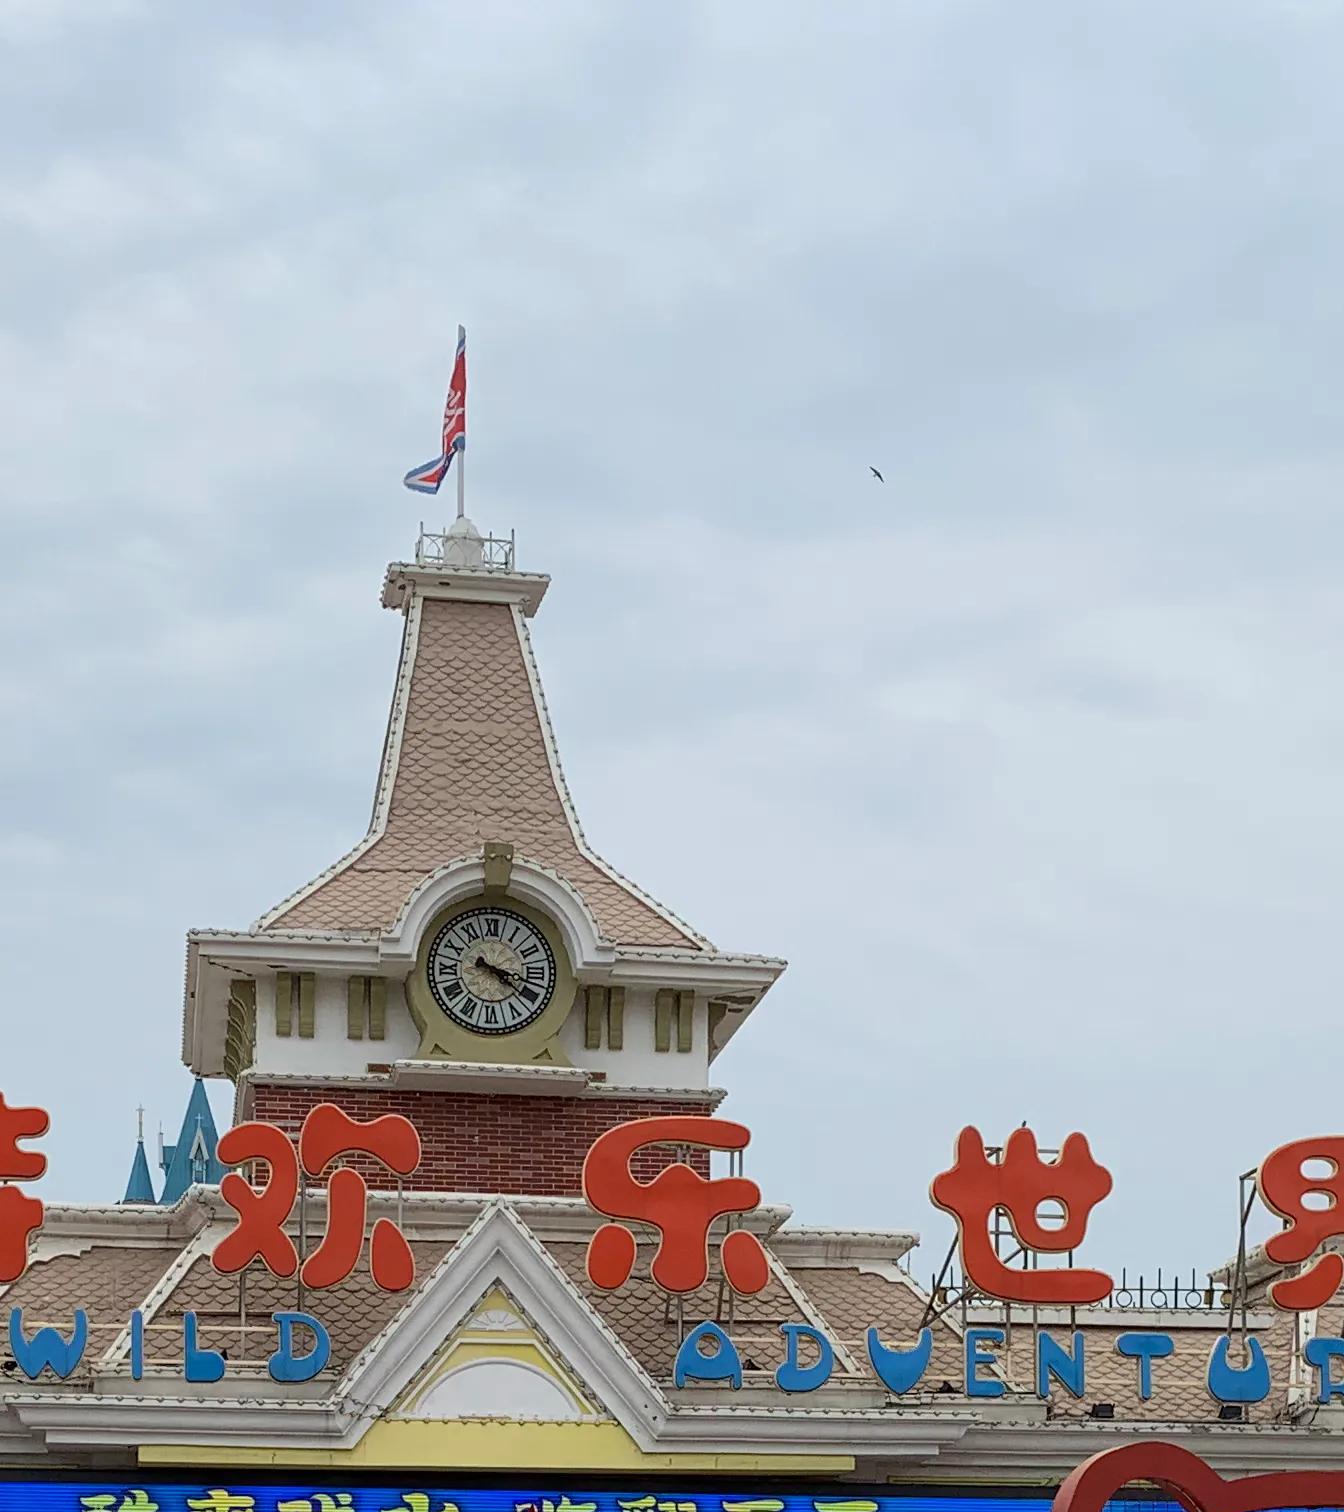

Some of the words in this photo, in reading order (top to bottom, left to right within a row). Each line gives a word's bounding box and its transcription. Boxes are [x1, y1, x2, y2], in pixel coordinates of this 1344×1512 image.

[461, 922, 480, 943] XI
[485, 918, 499, 937] XII
[508, 926, 521, 943] I
[444, 939, 464, 957] X
[521, 944, 539, 959] II
[439, 962, 457, 976] IX
[526, 966, 544, 981] III
[484, 1006, 499, 1024] VI
[508, 1002, 522, 1020] V
